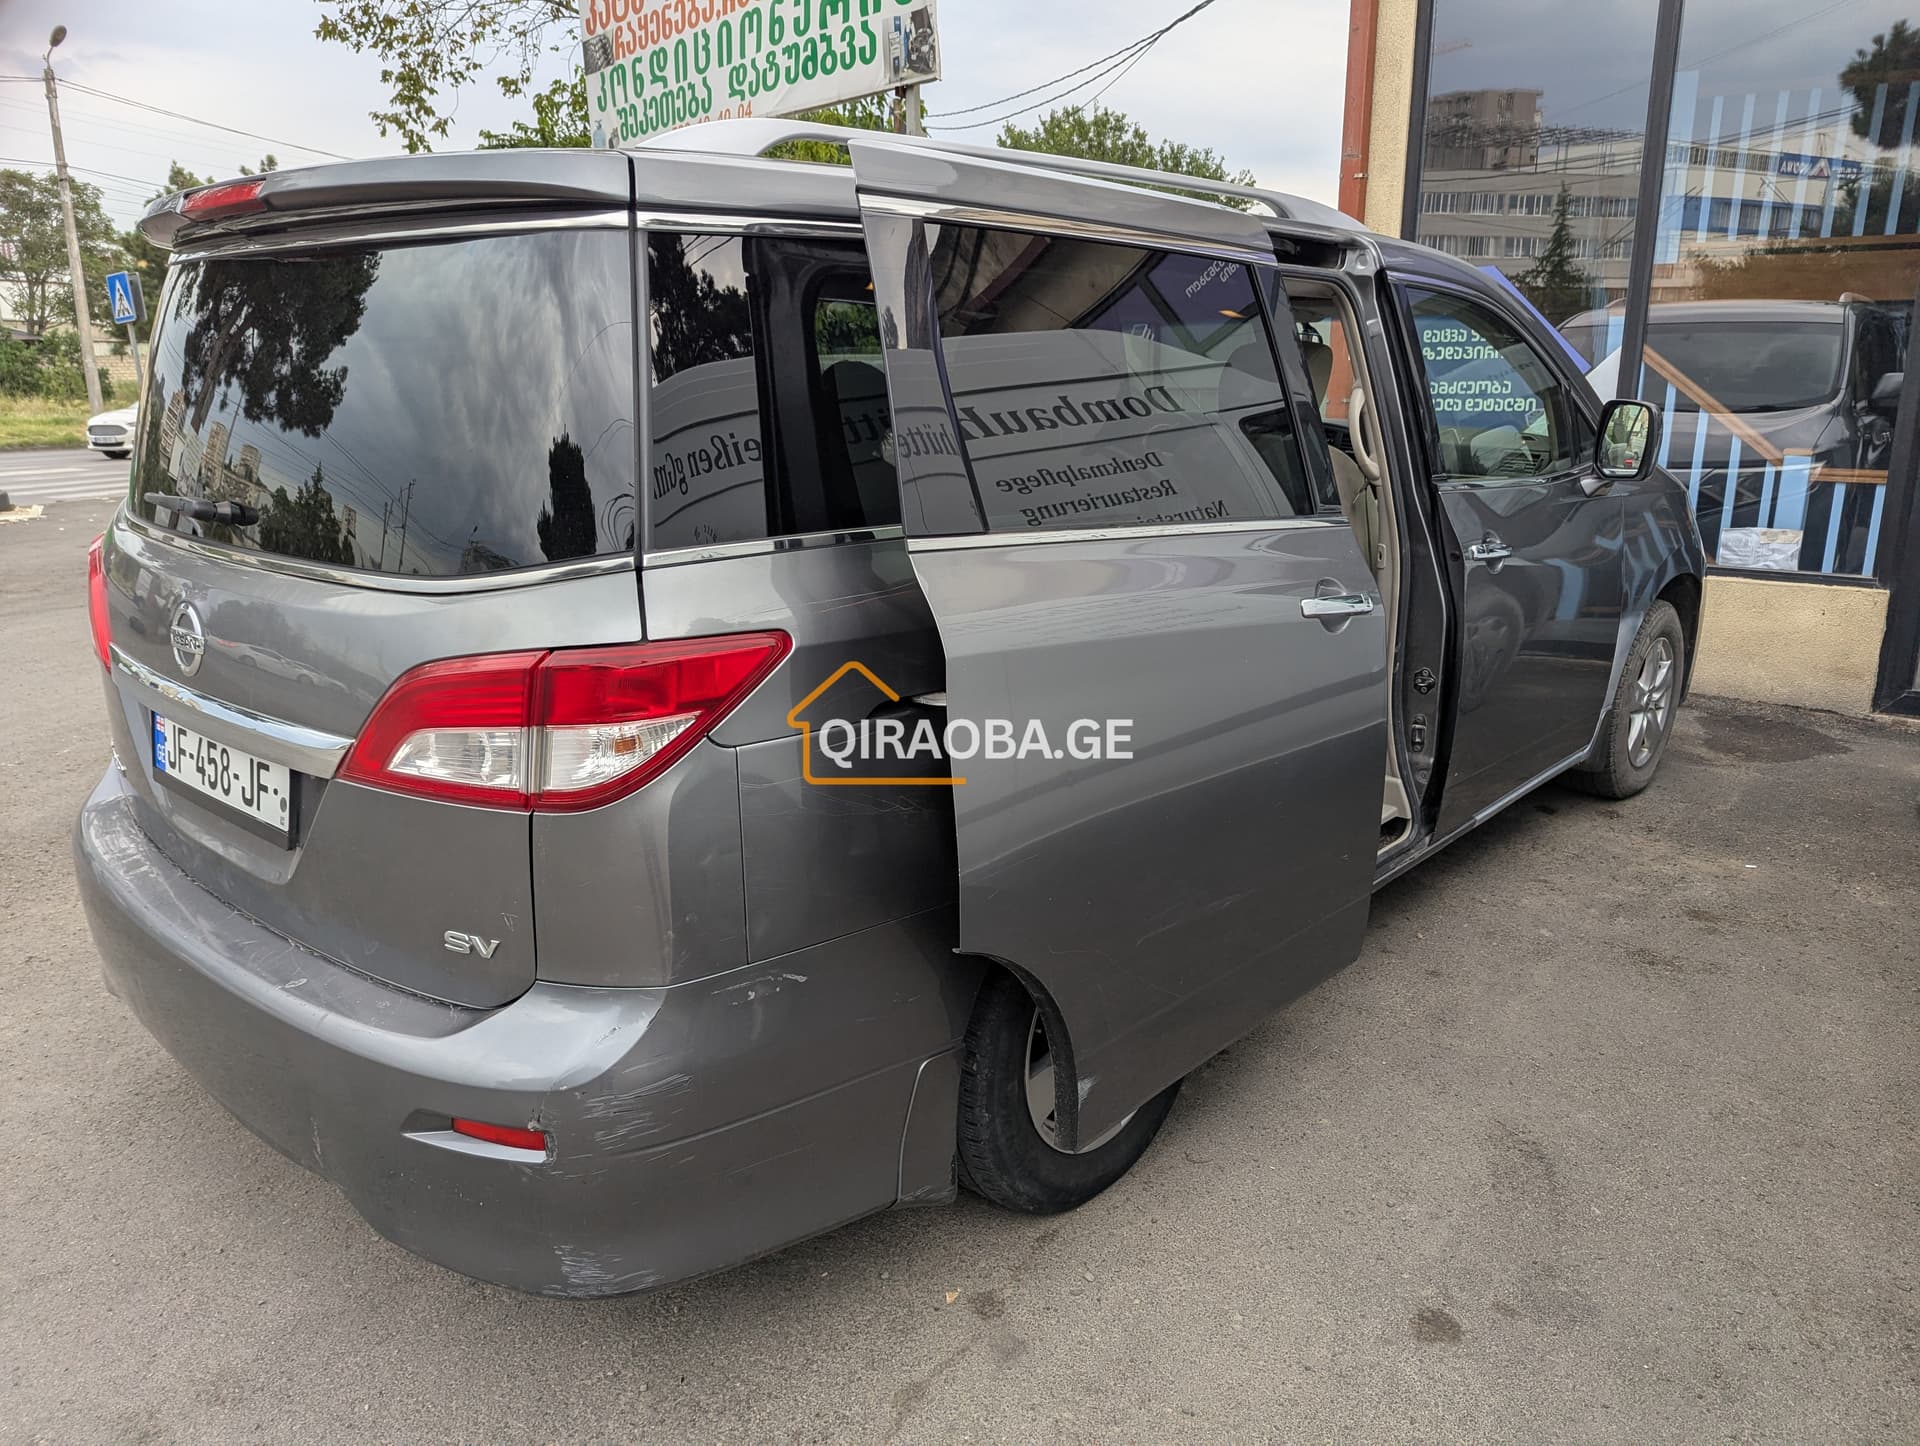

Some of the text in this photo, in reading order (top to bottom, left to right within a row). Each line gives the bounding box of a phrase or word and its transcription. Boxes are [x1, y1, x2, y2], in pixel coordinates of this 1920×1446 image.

[597, 0, 915, 112] კონდიციონერ
[616, 19, 877, 142] შეკეთება დატუმბვა
[738, 100, 753, 119] 04
[167, 724, 270, 812] JF-458-JF
[444, 930, 500, 959] SV
